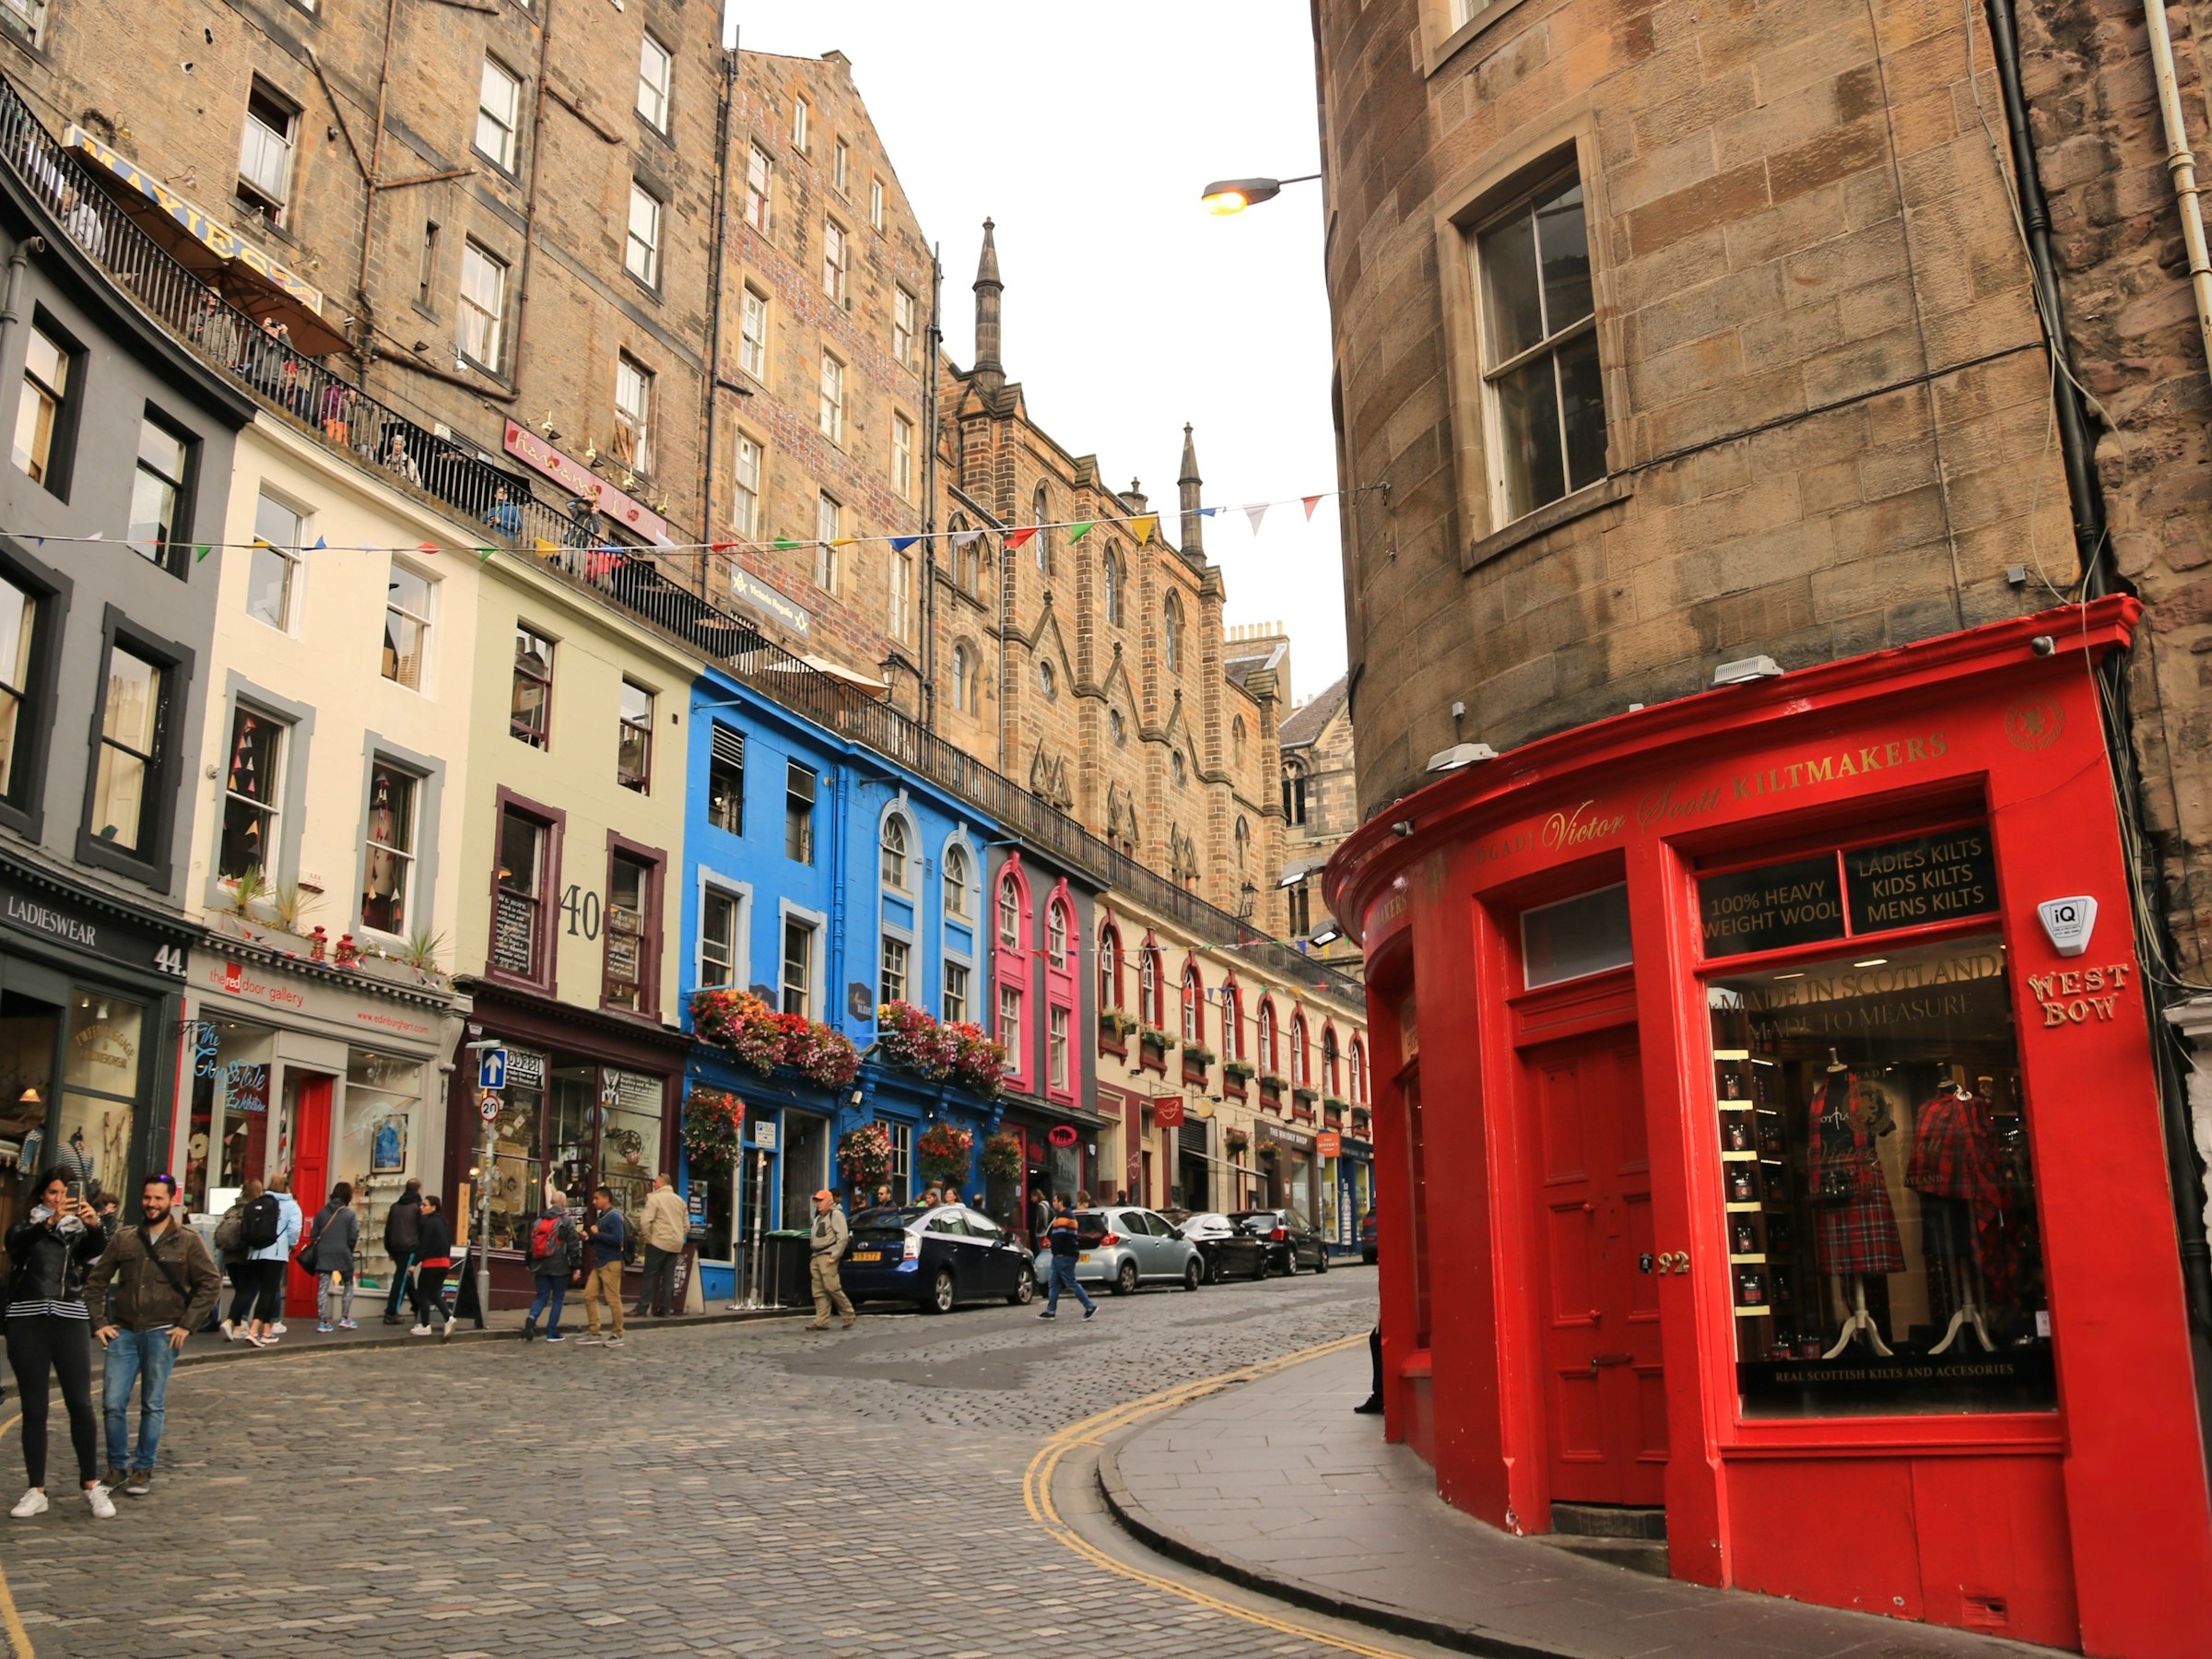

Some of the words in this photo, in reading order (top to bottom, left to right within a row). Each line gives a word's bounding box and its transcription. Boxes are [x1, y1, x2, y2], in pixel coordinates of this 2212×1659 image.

[1542, 800, 1625, 852] Victor
[1637, 782, 1721, 834] Scott
[1732, 731, 1949, 801] KILTMAKERS
[1859, 850, 1925, 877] LADIES
[1931, 838, 1982, 863] KILTS
[1712, 892, 1759, 916] 100%
[1765, 880, 1826, 906] HEAVY
[1872, 876, 1916, 898] KIDS
[1922, 864, 1973, 888] KILTS
[7, 896, 96, 947] LADIESWEAR
[560, 885, 600, 941] 40
[1702, 912, 1775, 938] WEIGHT
[1781, 900, 1841, 926] WOOL
[1867, 896, 1926, 923] MENS
[1932, 886, 1984, 911] KILTS
[2054, 906, 2076, 923] iQ
[209, 969, 225, 984] the
[225, 975, 241, 988] red
[241, 977, 265, 994] door
[269, 987, 304, 1007] gallery
[1720, 985, 1799, 1016] MADE
[1805, 977, 1835, 1003] IN
[1842, 955, 1998, 997] SCOTLAND
[2028, 964, 2130, 1002] WEST
[357, 1011, 429, 1034] www.edinburghart.com
[1748, 1017, 1806, 1041] MADE
[1824, 1009, 1852, 1031] TO
[1860, 993, 1974, 1027] MEASURE
[2041, 993, 2119, 1028] BOW
[483, 1103, 497, 1114] 20
[1270, 1127, 1278, 1136] THE
[1278, 1129, 1296, 1142] WHISKY
[1296, 1135, 1308, 1145] SHOP
[1775, 1371, 1805, 1382] REAL
[1807, 1369, 1865, 1381] SCOTTISH
[1869, 1368, 1903, 1380] KILTS
[1906, 1367, 1933, 1378] AND
[1936, 1363, 2015, 1377] ACCESORIES
